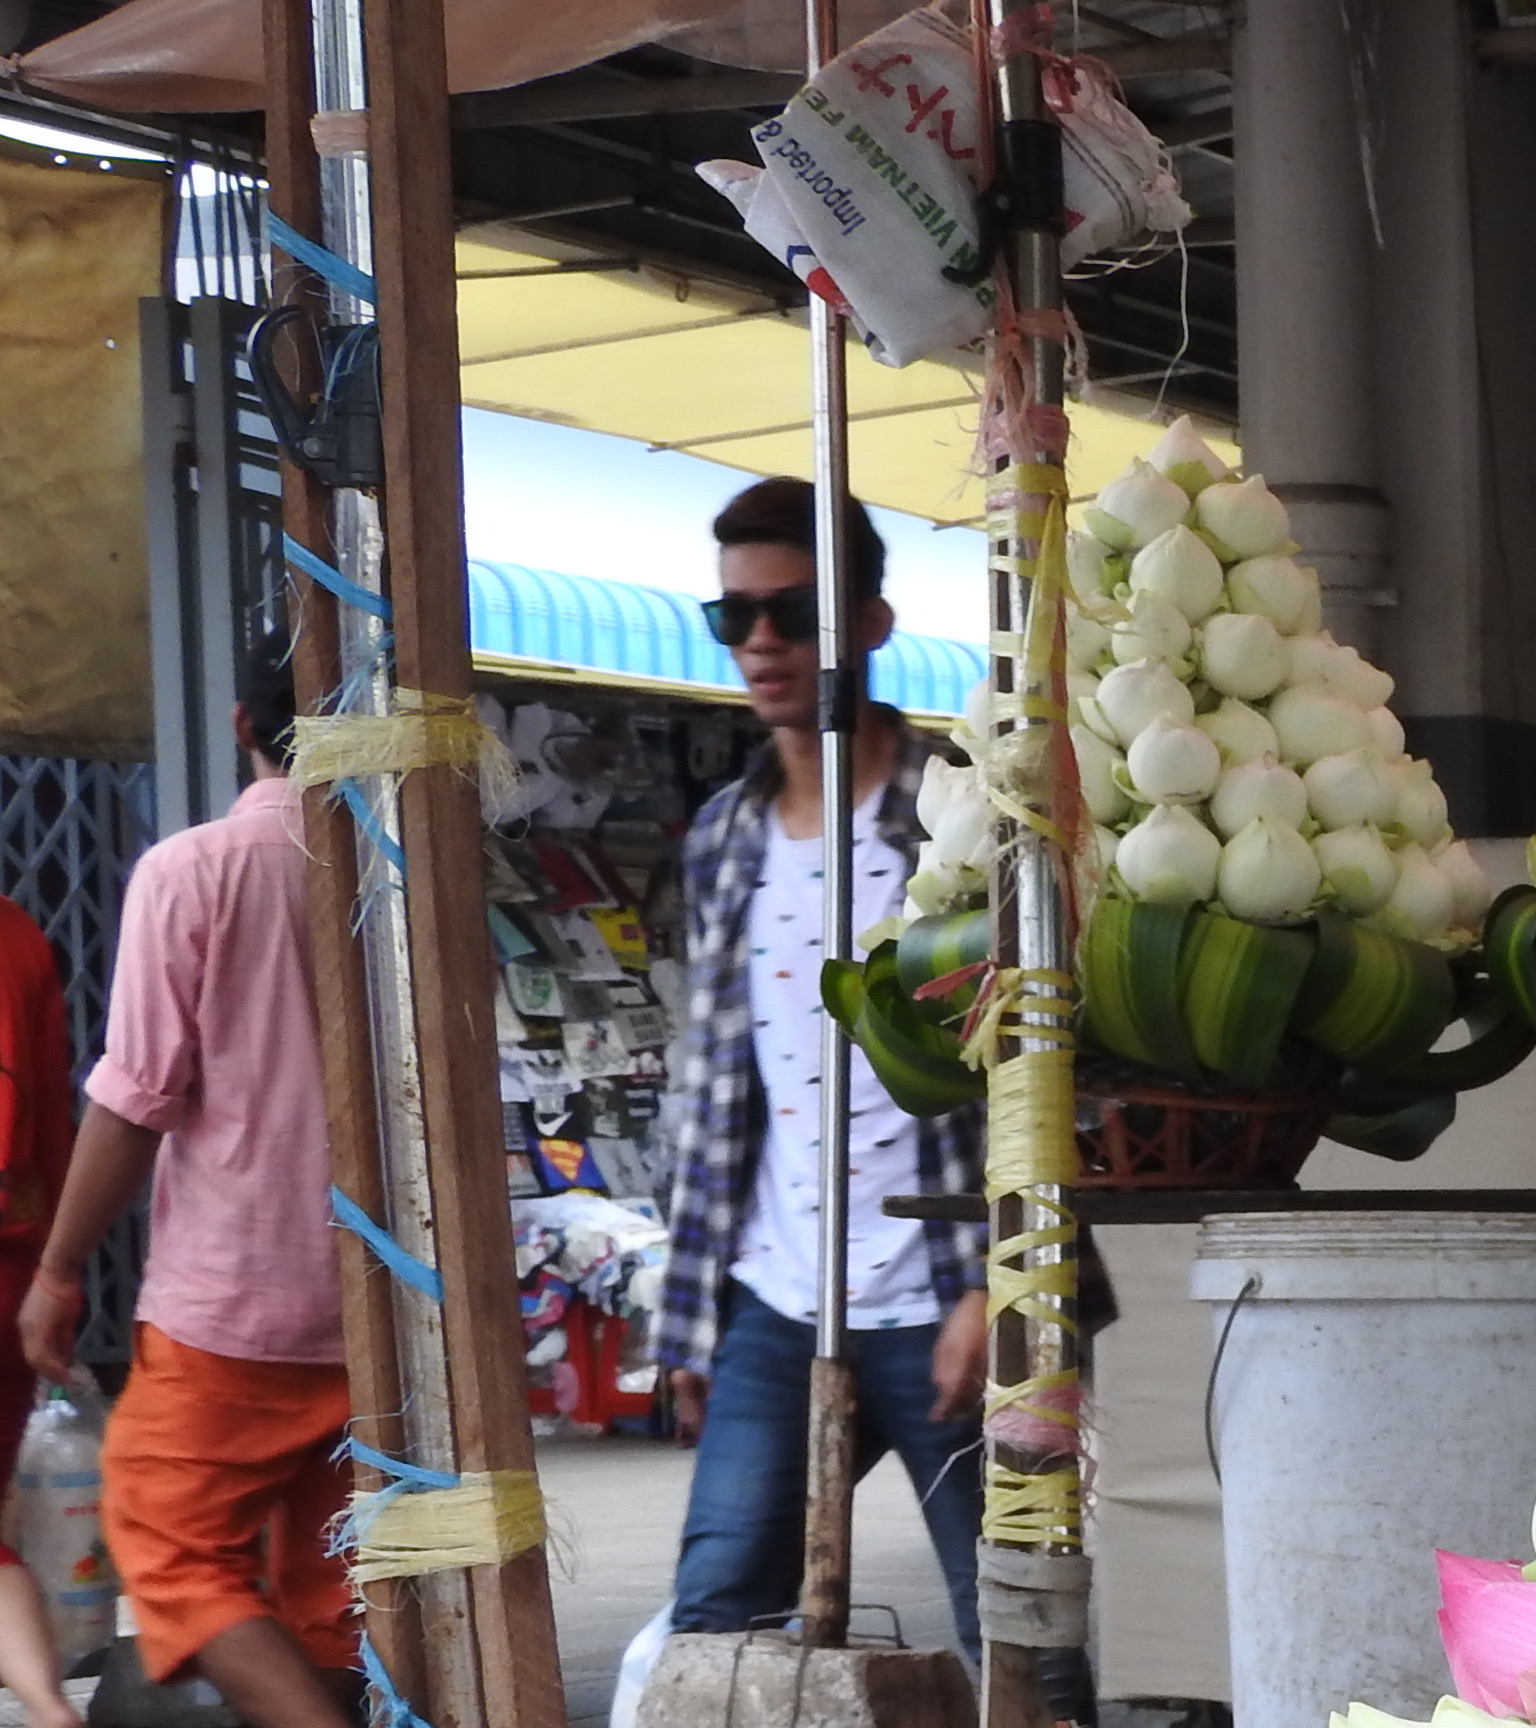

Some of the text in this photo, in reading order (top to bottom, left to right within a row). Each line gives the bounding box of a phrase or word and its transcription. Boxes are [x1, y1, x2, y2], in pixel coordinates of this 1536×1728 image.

[800, 86, 845, 127] FE
[755, 120, 866, 237] Imported &
[845, 124, 958, 249] VIETNAM
